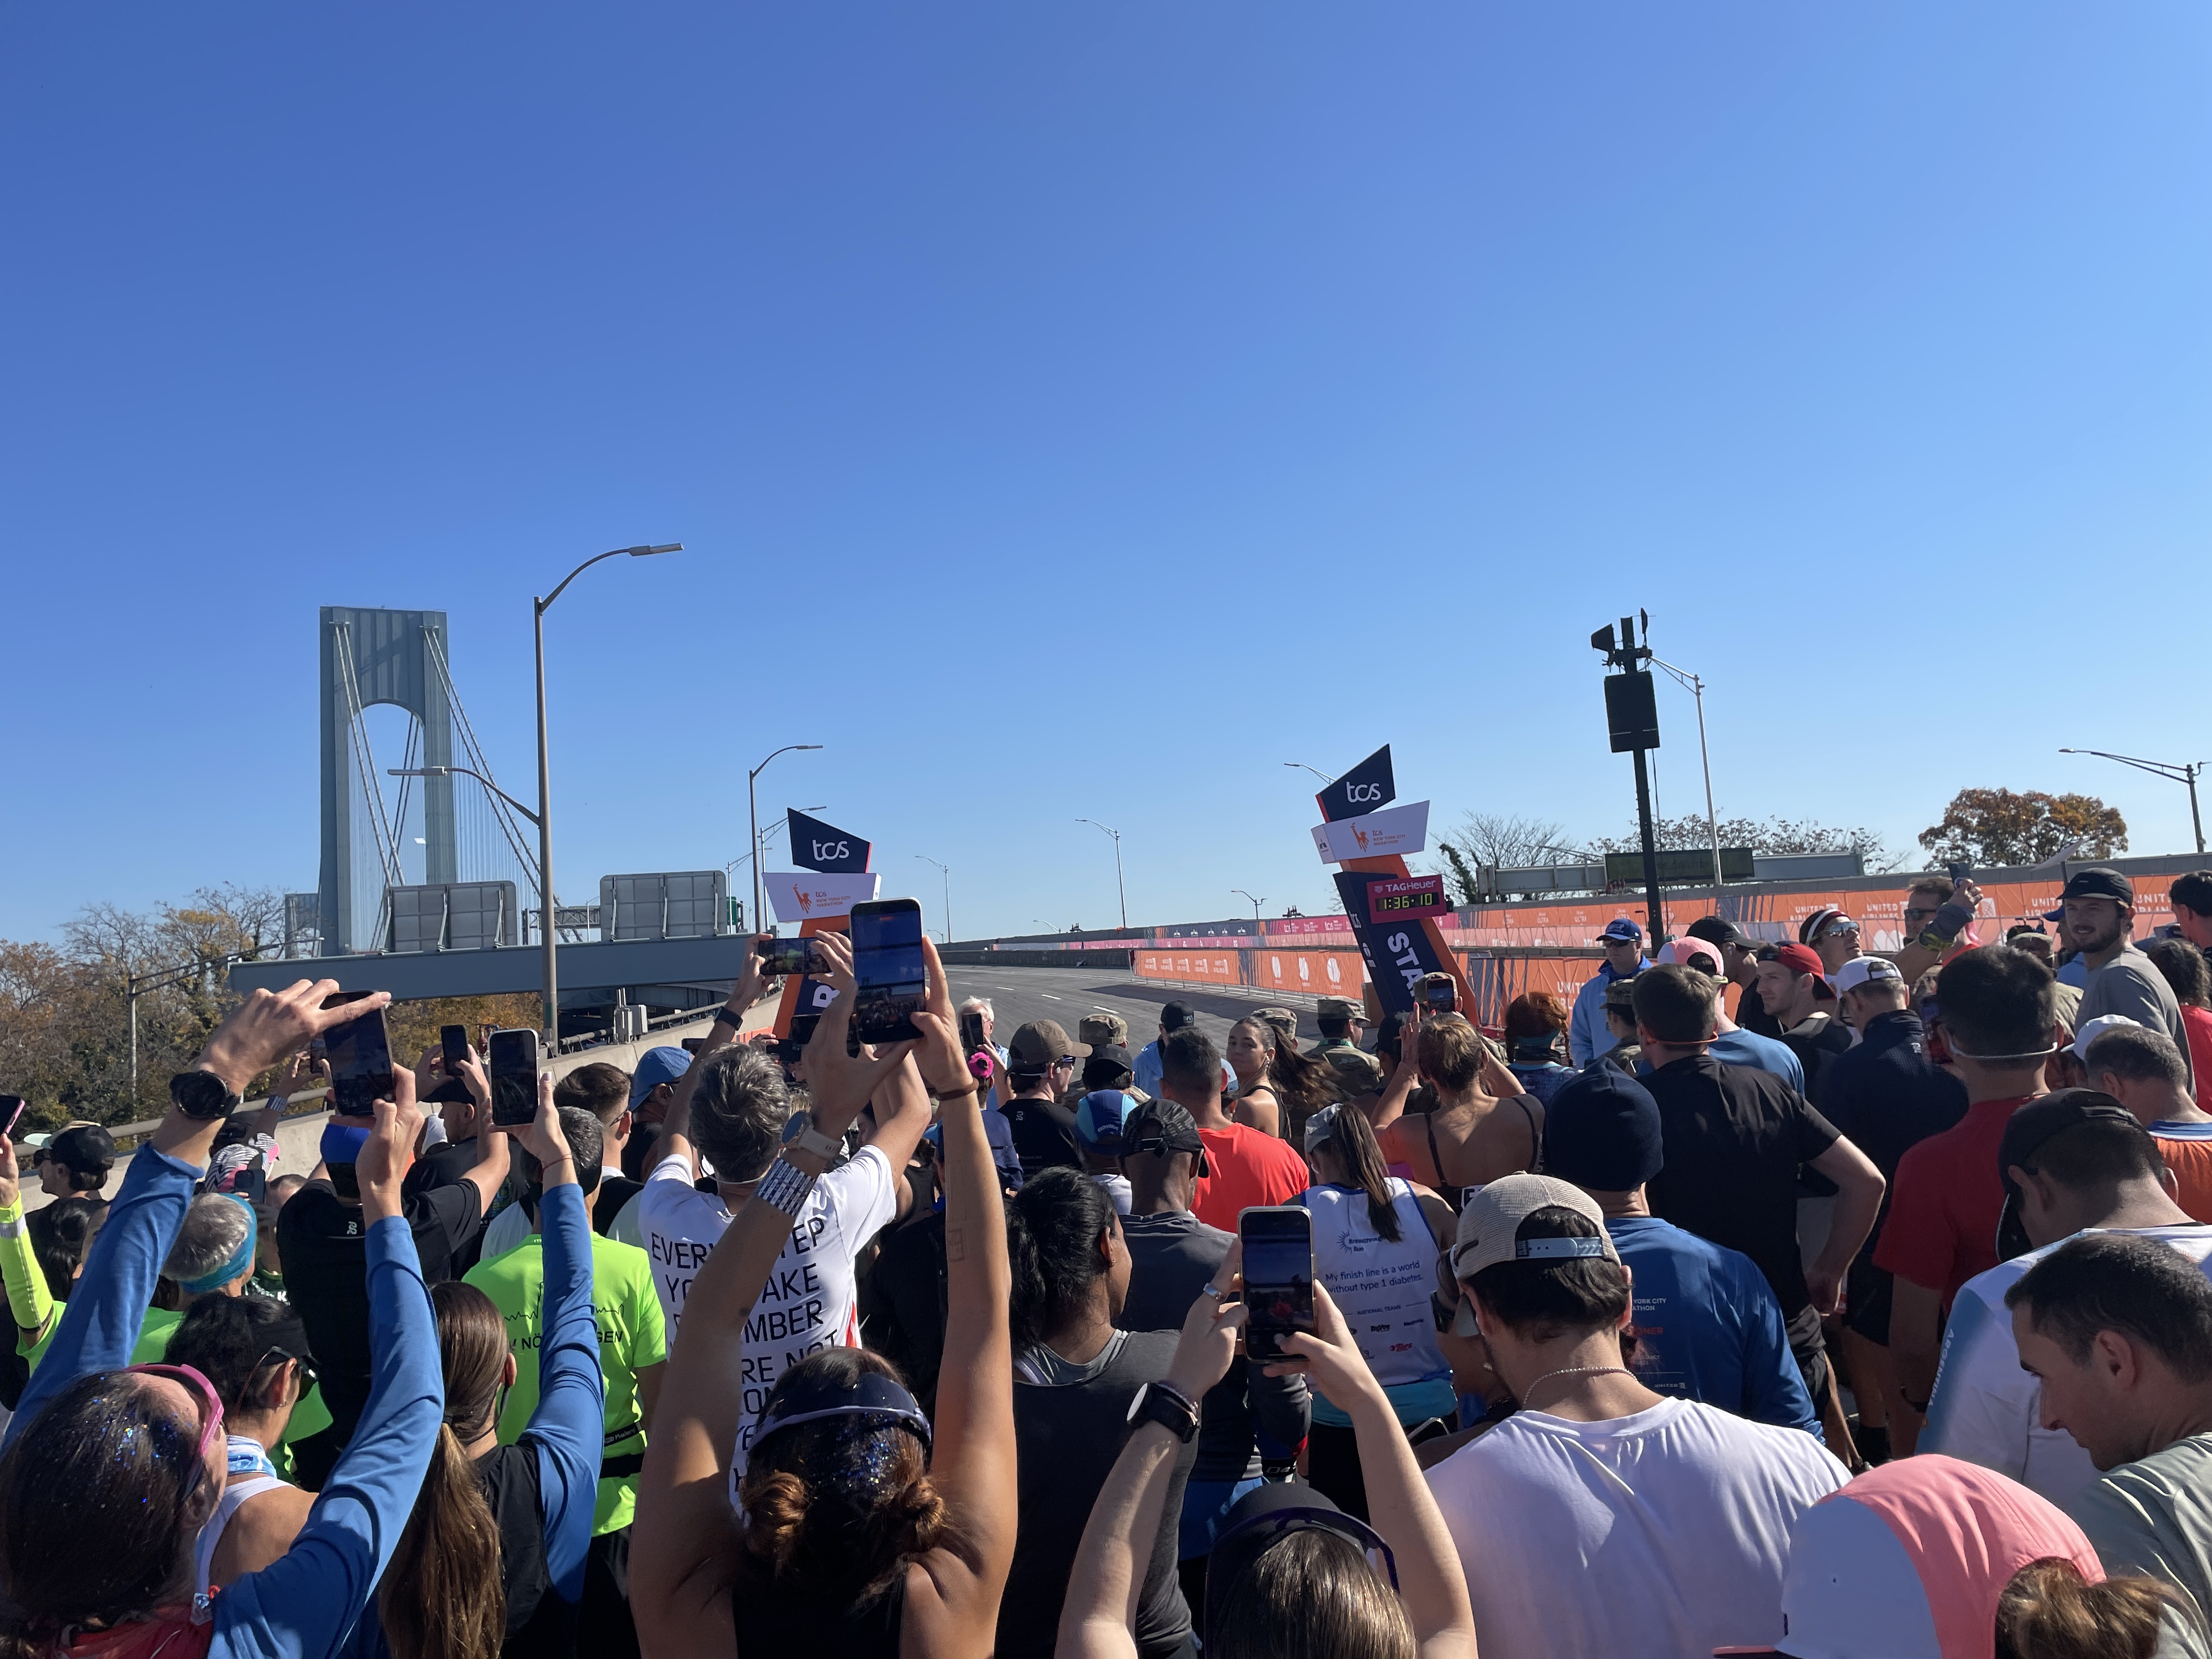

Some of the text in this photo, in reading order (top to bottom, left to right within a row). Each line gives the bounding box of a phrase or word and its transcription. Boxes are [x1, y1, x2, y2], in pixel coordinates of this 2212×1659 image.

[1346, 781, 1381, 803] tcs
[812, 839, 849, 861] tcs
[1867, 904, 1898, 912] UNITED
[2032, 898, 2063, 907] UNITE
[2135, 894, 2171, 904] UNIT
[1324, 921, 1334, 931] tcs
[1387, 932, 1425, 997] STA
[1557, 981, 1585, 994] UNIT
[651, 1232, 714, 1269] EVER
[1325, 1273, 1339, 1282] My
[1341, 1271, 1364, 1280] finish
[1365, 1268, 1380, 1277] line
[1382, 1266, 1390, 1276] is
[1398, 1260, 1420, 1272] world
[762, 1263, 820, 1304] AKE
[1361, 1280, 1379, 1292] type
[1381, 1279, 1387, 1287] 1
[1389, 1273, 1424, 1286] diabetes.
[1927, 1329, 1954, 1406] ARGENTINA
